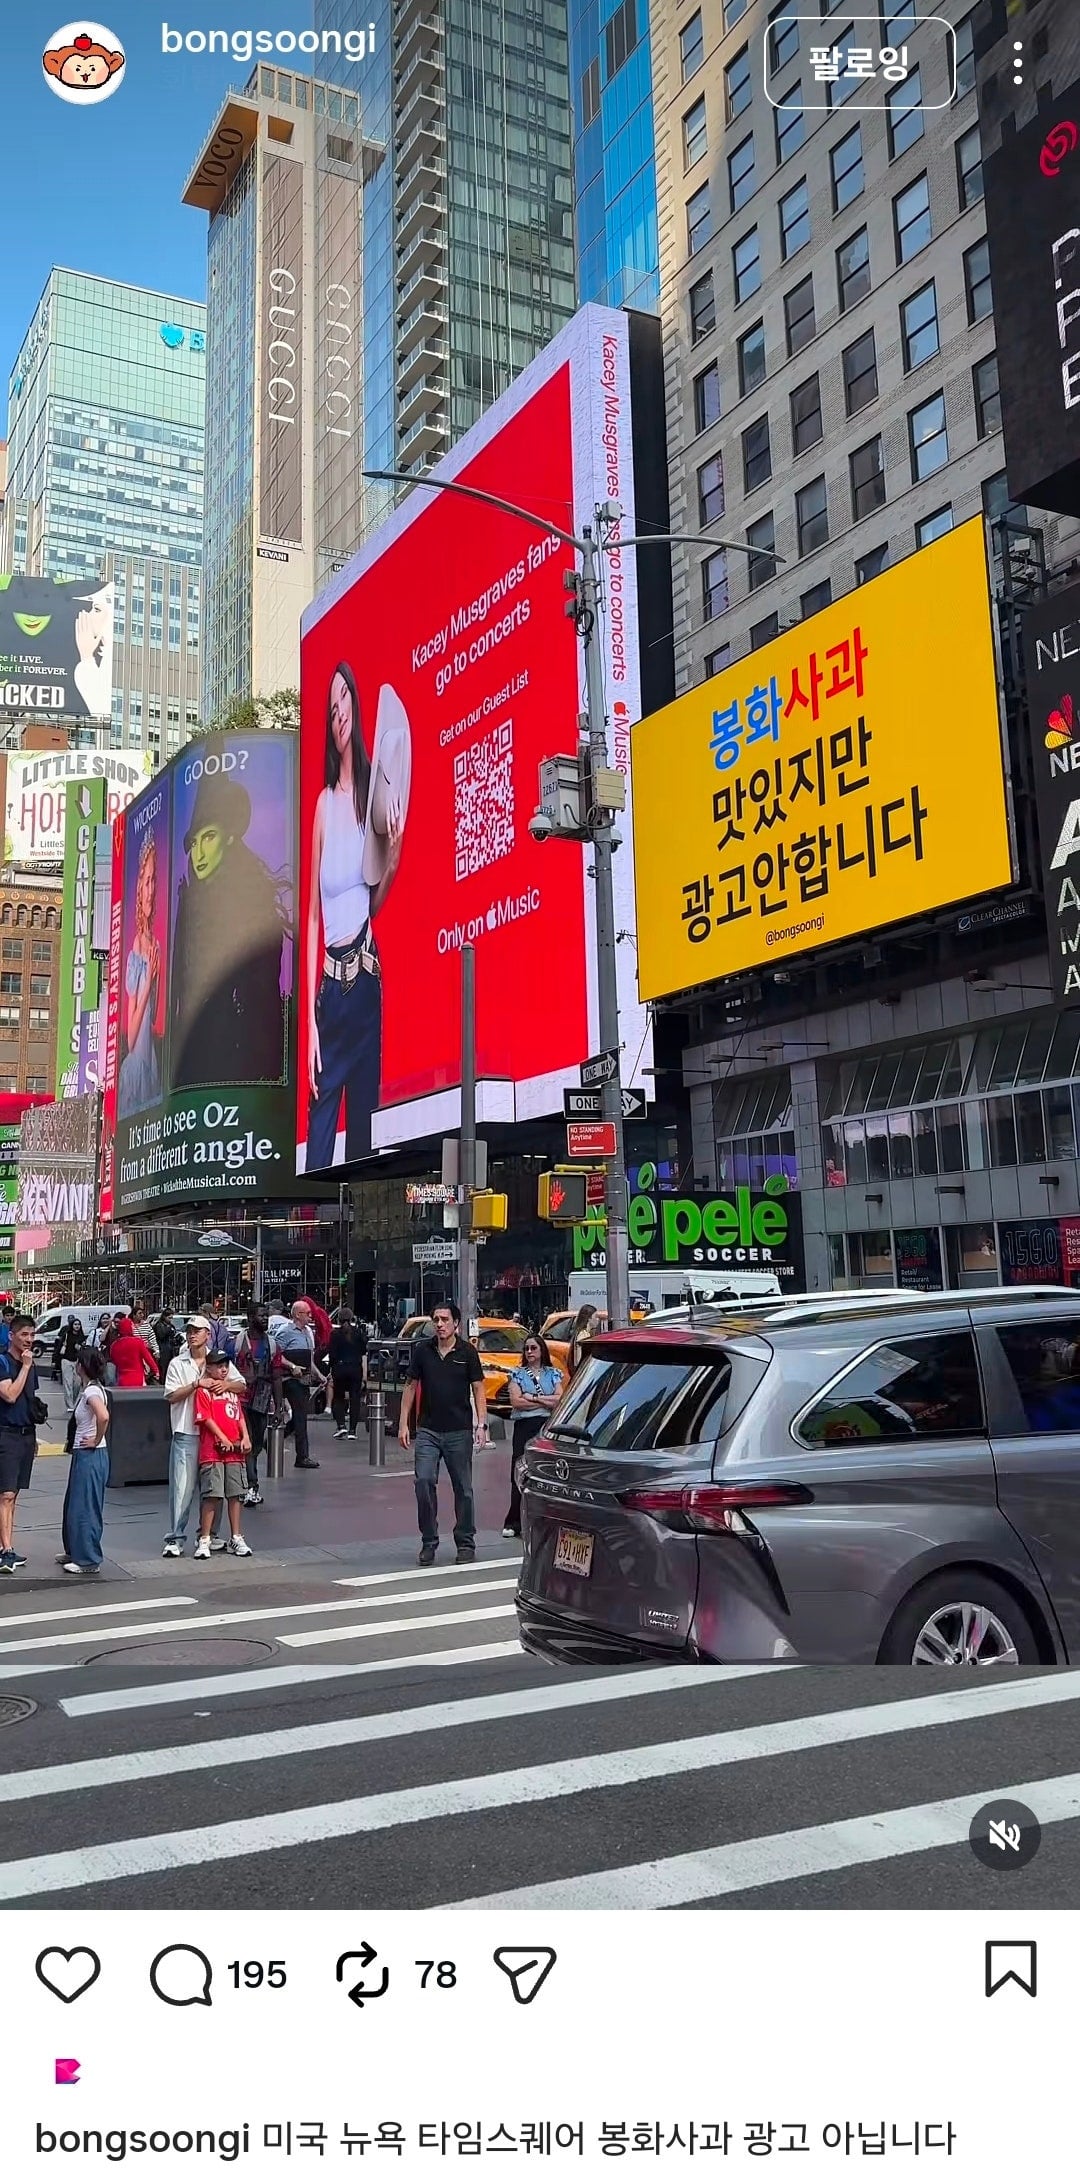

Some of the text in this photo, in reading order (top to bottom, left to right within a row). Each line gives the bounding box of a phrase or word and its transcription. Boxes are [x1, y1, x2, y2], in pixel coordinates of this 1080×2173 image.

[268, 268, 296, 425] GUCCI
[600, 334, 618, 392] Kacey
[602, 392, 620, 498] Musgraves
[259, 548, 288, 562] KEVANI
[412, 534, 561, 673] Kacey Musgraves fans
[610, 574, 625, 593] to
[20, 655, 44, 664] LIVE.
[435, 598, 531, 697] go to concerts
[610, 596, 627, 682] concerts
[23, 665, 68, 676] FOREVER.
[439, 669, 529, 747] Get on our Guest List
[708, 625, 869, 771] 봉화사과
[22, 754, 140, 788] LITTLE SHOP
[184, 750, 249, 786] GOOD?
[712, 715, 874, 850] 맛있지만
[133, 791, 163, 835] WICKED?
[680, 783, 930, 945] 광고안합니다
[71, 824, 90, 1053] CANNABIS
[437, 885, 540, 954] Only on Music
[765, 912, 825, 946] @bongsoongi
[105, 900, 122, 1092] HERSHEY'S STORE
[585, 1060, 613, 1081] ONE WAY
[128, 1102, 239, 1150] It's time to see Oz
[576, 1097, 599, 1109] ONE
[579, 1126, 604, 1134] STANDING
[120, 1158, 138, 1183] from
[139, 1160, 145, 1177] a
[147, 1140, 188, 1175] different
[193, 1131, 281, 1169] angle.
[694, 1247, 773, 1262] SOCCER
[1005, 1227, 1058, 1266] 1560
[775, 1266, 795, 1276] STORE
[536, 1482, 594, 1500] SIENNA
